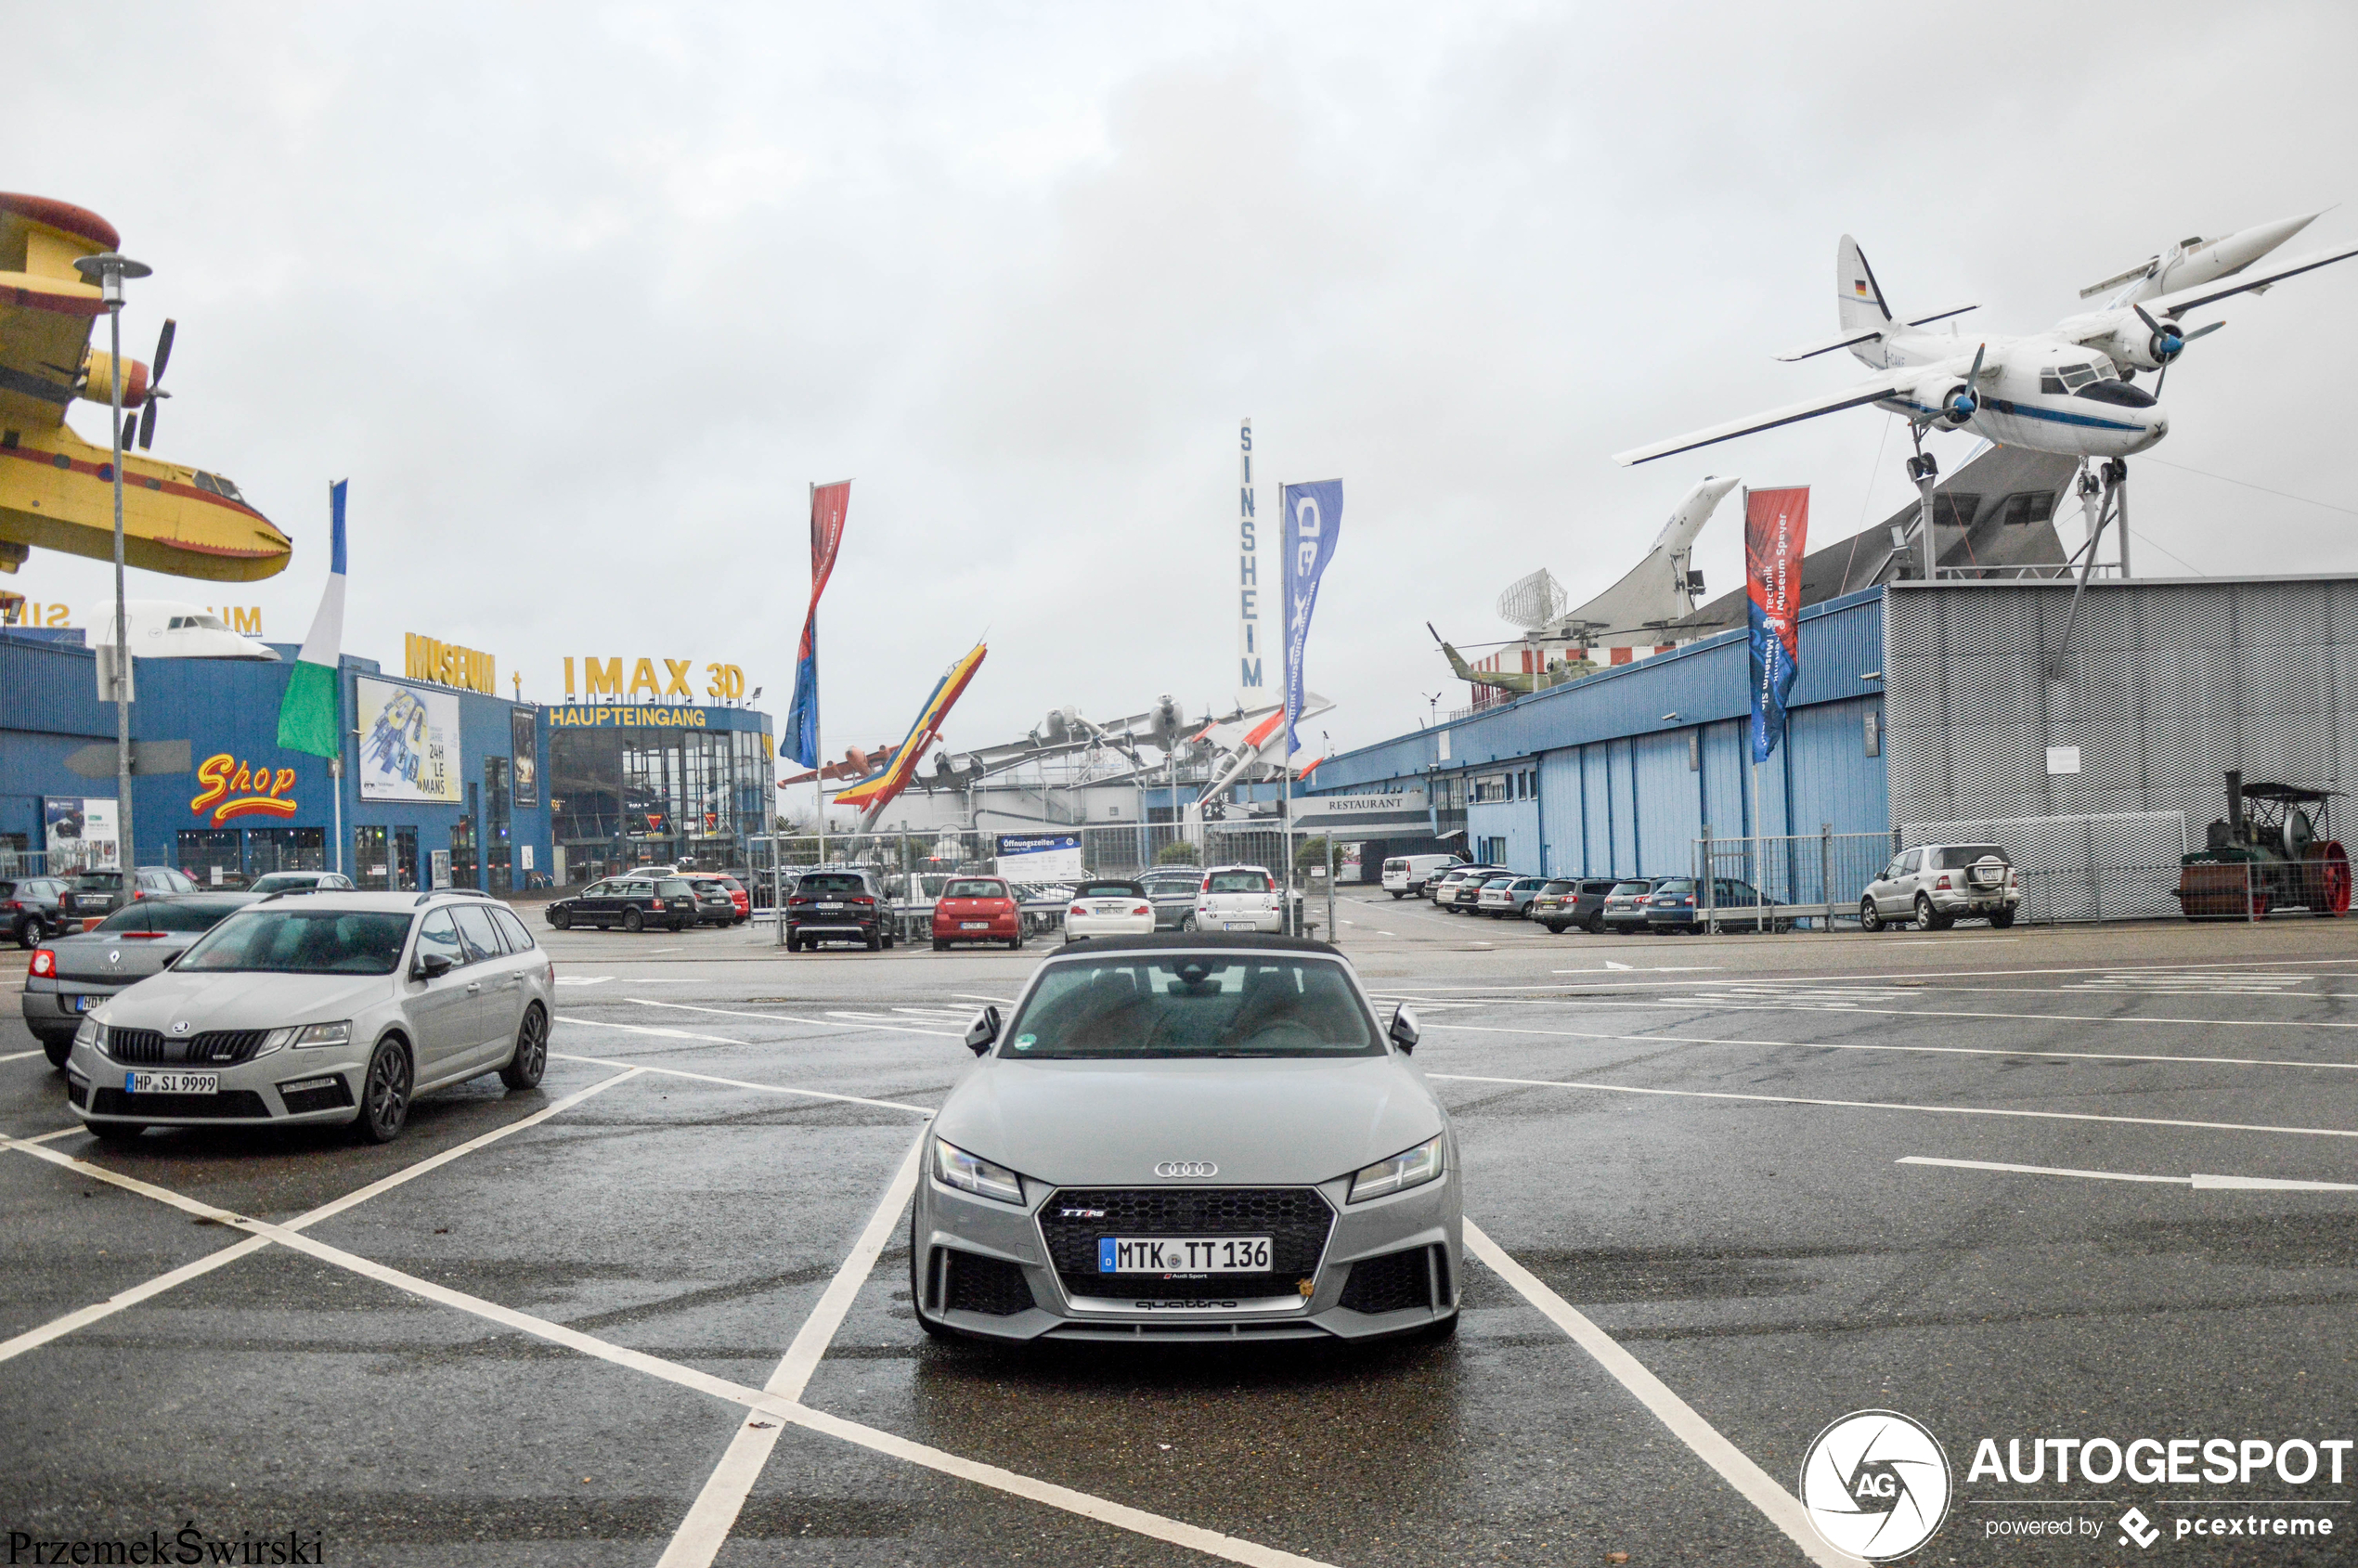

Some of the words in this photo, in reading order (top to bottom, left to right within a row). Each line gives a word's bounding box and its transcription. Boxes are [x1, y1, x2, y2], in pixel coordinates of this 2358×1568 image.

[1777, 513, 1788, 555] Speyer
[1240, 426, 1263, 687] SINSHEIM
[1777, 560, 1786, 611] Museum
[405, 632, 496, 694] MUSEUM
[564, 657, 693, 695] IMAX
[706, 663, 745, 698] 3D
[550, 708, 706, 727] HAUPTEINGANG
[429, 744, 444, 759] 24H
[434, 762, 444, 777] LE
[189, 753, 296, 816] Shop
[422, 779, 445, 795] MANS
[1329, 798, 1403, 810] RESTAURANT
[1004, 839, 1055, 848] Öffnungszeiten
[136, 1076, 151, 1090] HP
[162, 1076, 177, 1091] SI
[182, 1077, 215, 1091] 9999
[1118, 1242, 1164, 1268] MTK
[1185, 1242, 1215, 1268] TT
[1224, 1241, 1268, 1268] 136
[1135, 1301, 1237, 1310] quattro
